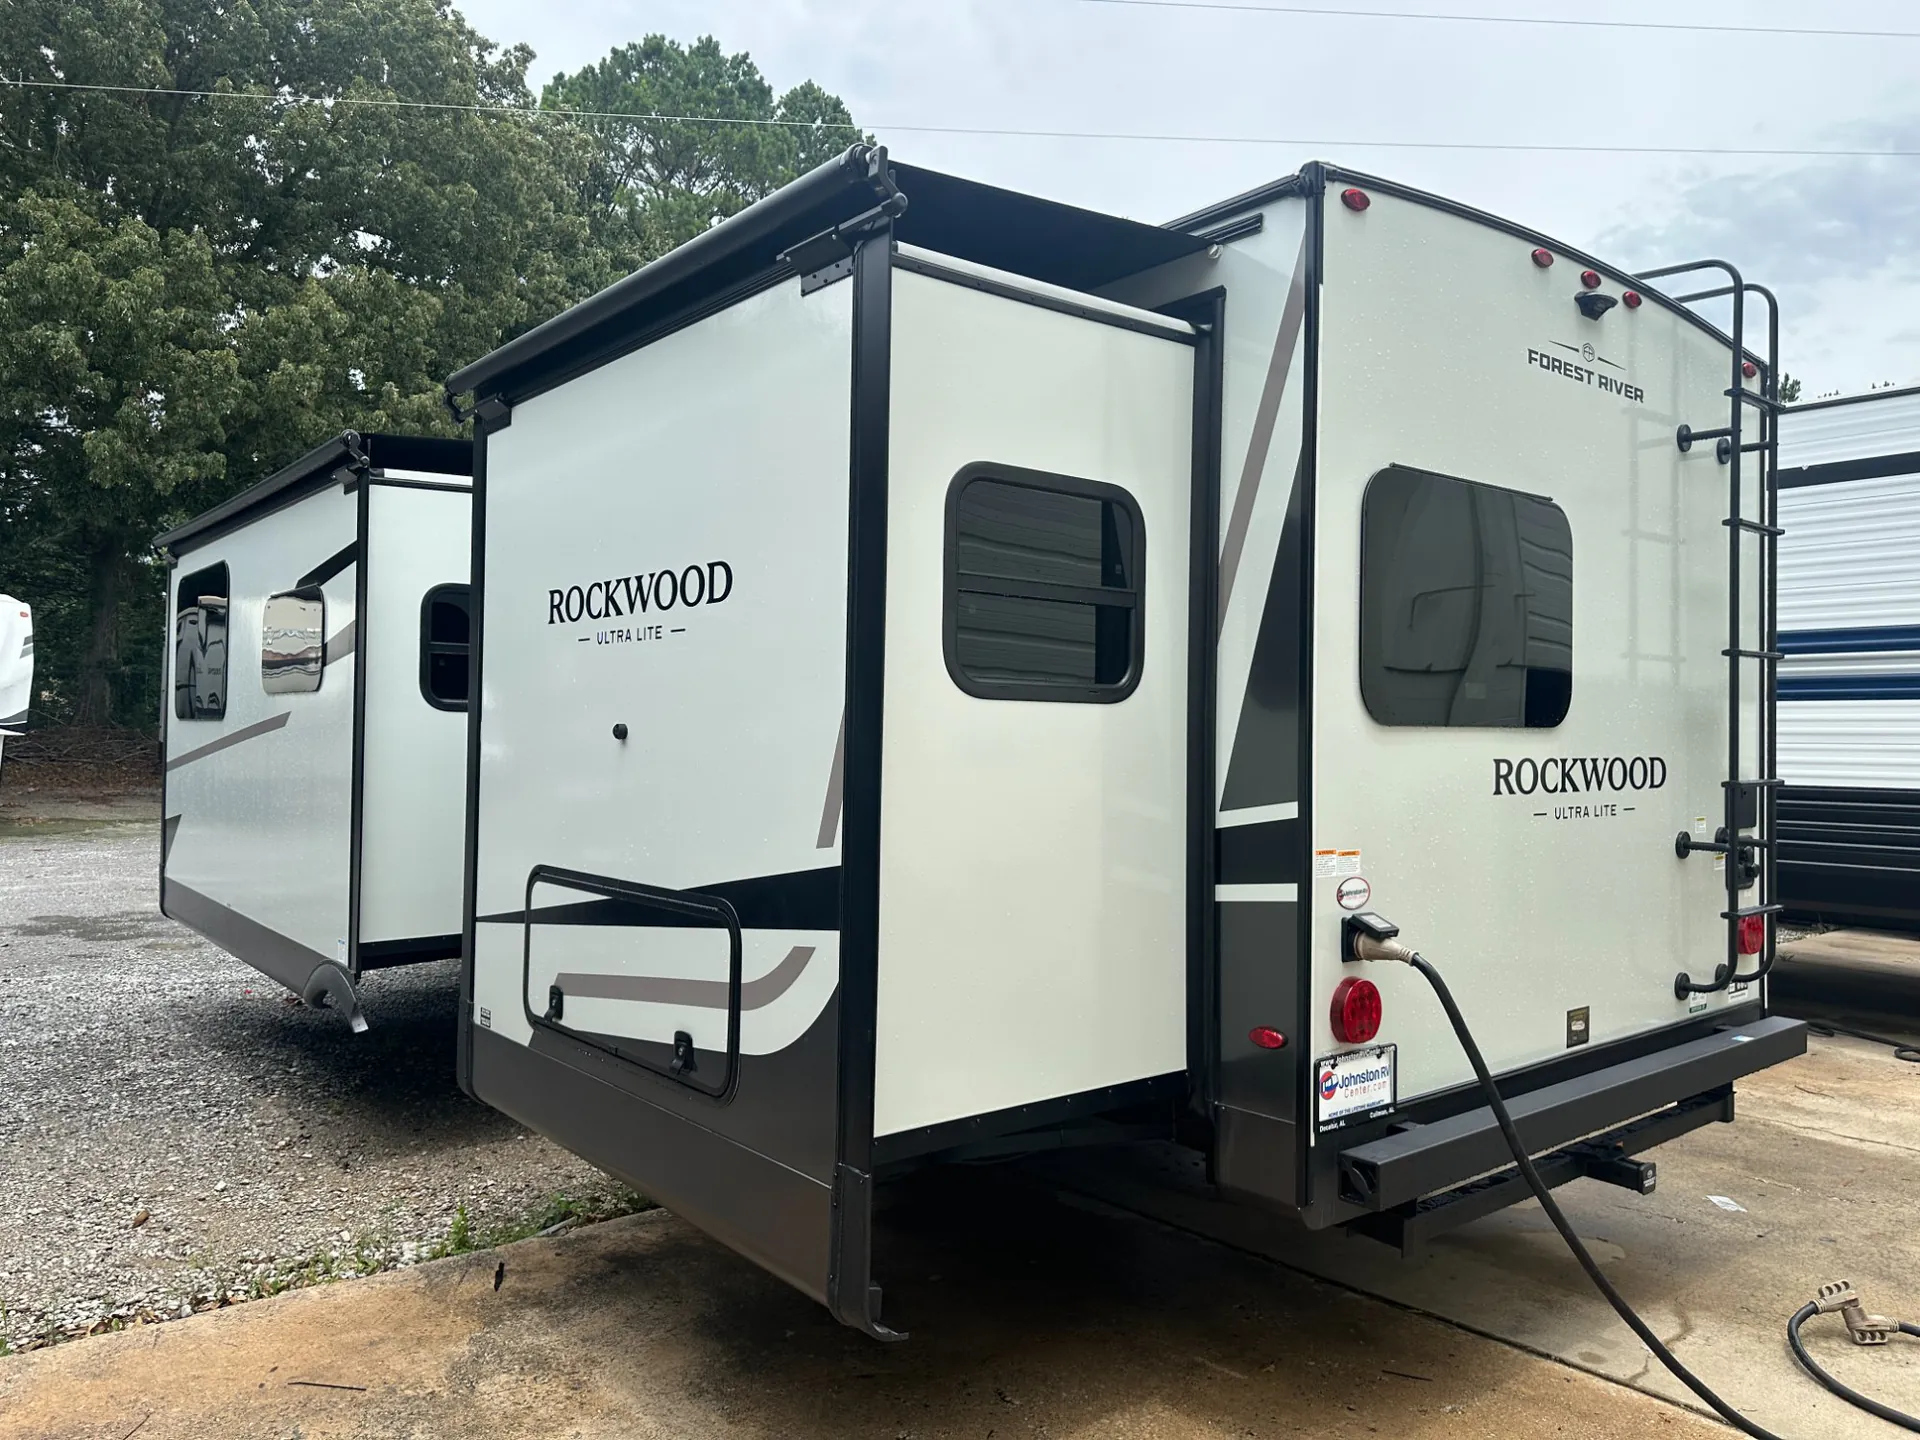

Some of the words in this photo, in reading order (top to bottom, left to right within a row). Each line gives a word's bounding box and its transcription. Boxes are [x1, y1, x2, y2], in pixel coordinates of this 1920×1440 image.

[1527, 348, 1595, 385] FOREST
[1597, 373, 1645, 404] RIVER
[547, 560, 733, 625] ROCKWOOD
[596, 628, 632, 645] ULTRA
[636, 625, 663, 642] LITE
[1492, 756, 1667, 796] ROCKWOOD
[1554, 805, 1590, 820] ULTRA
[1593, 803, 1617, 818] LITE
[1338, 1069, 1380, 1089] Johnston
[1344, 1080, 1387, 1099] Center.com
